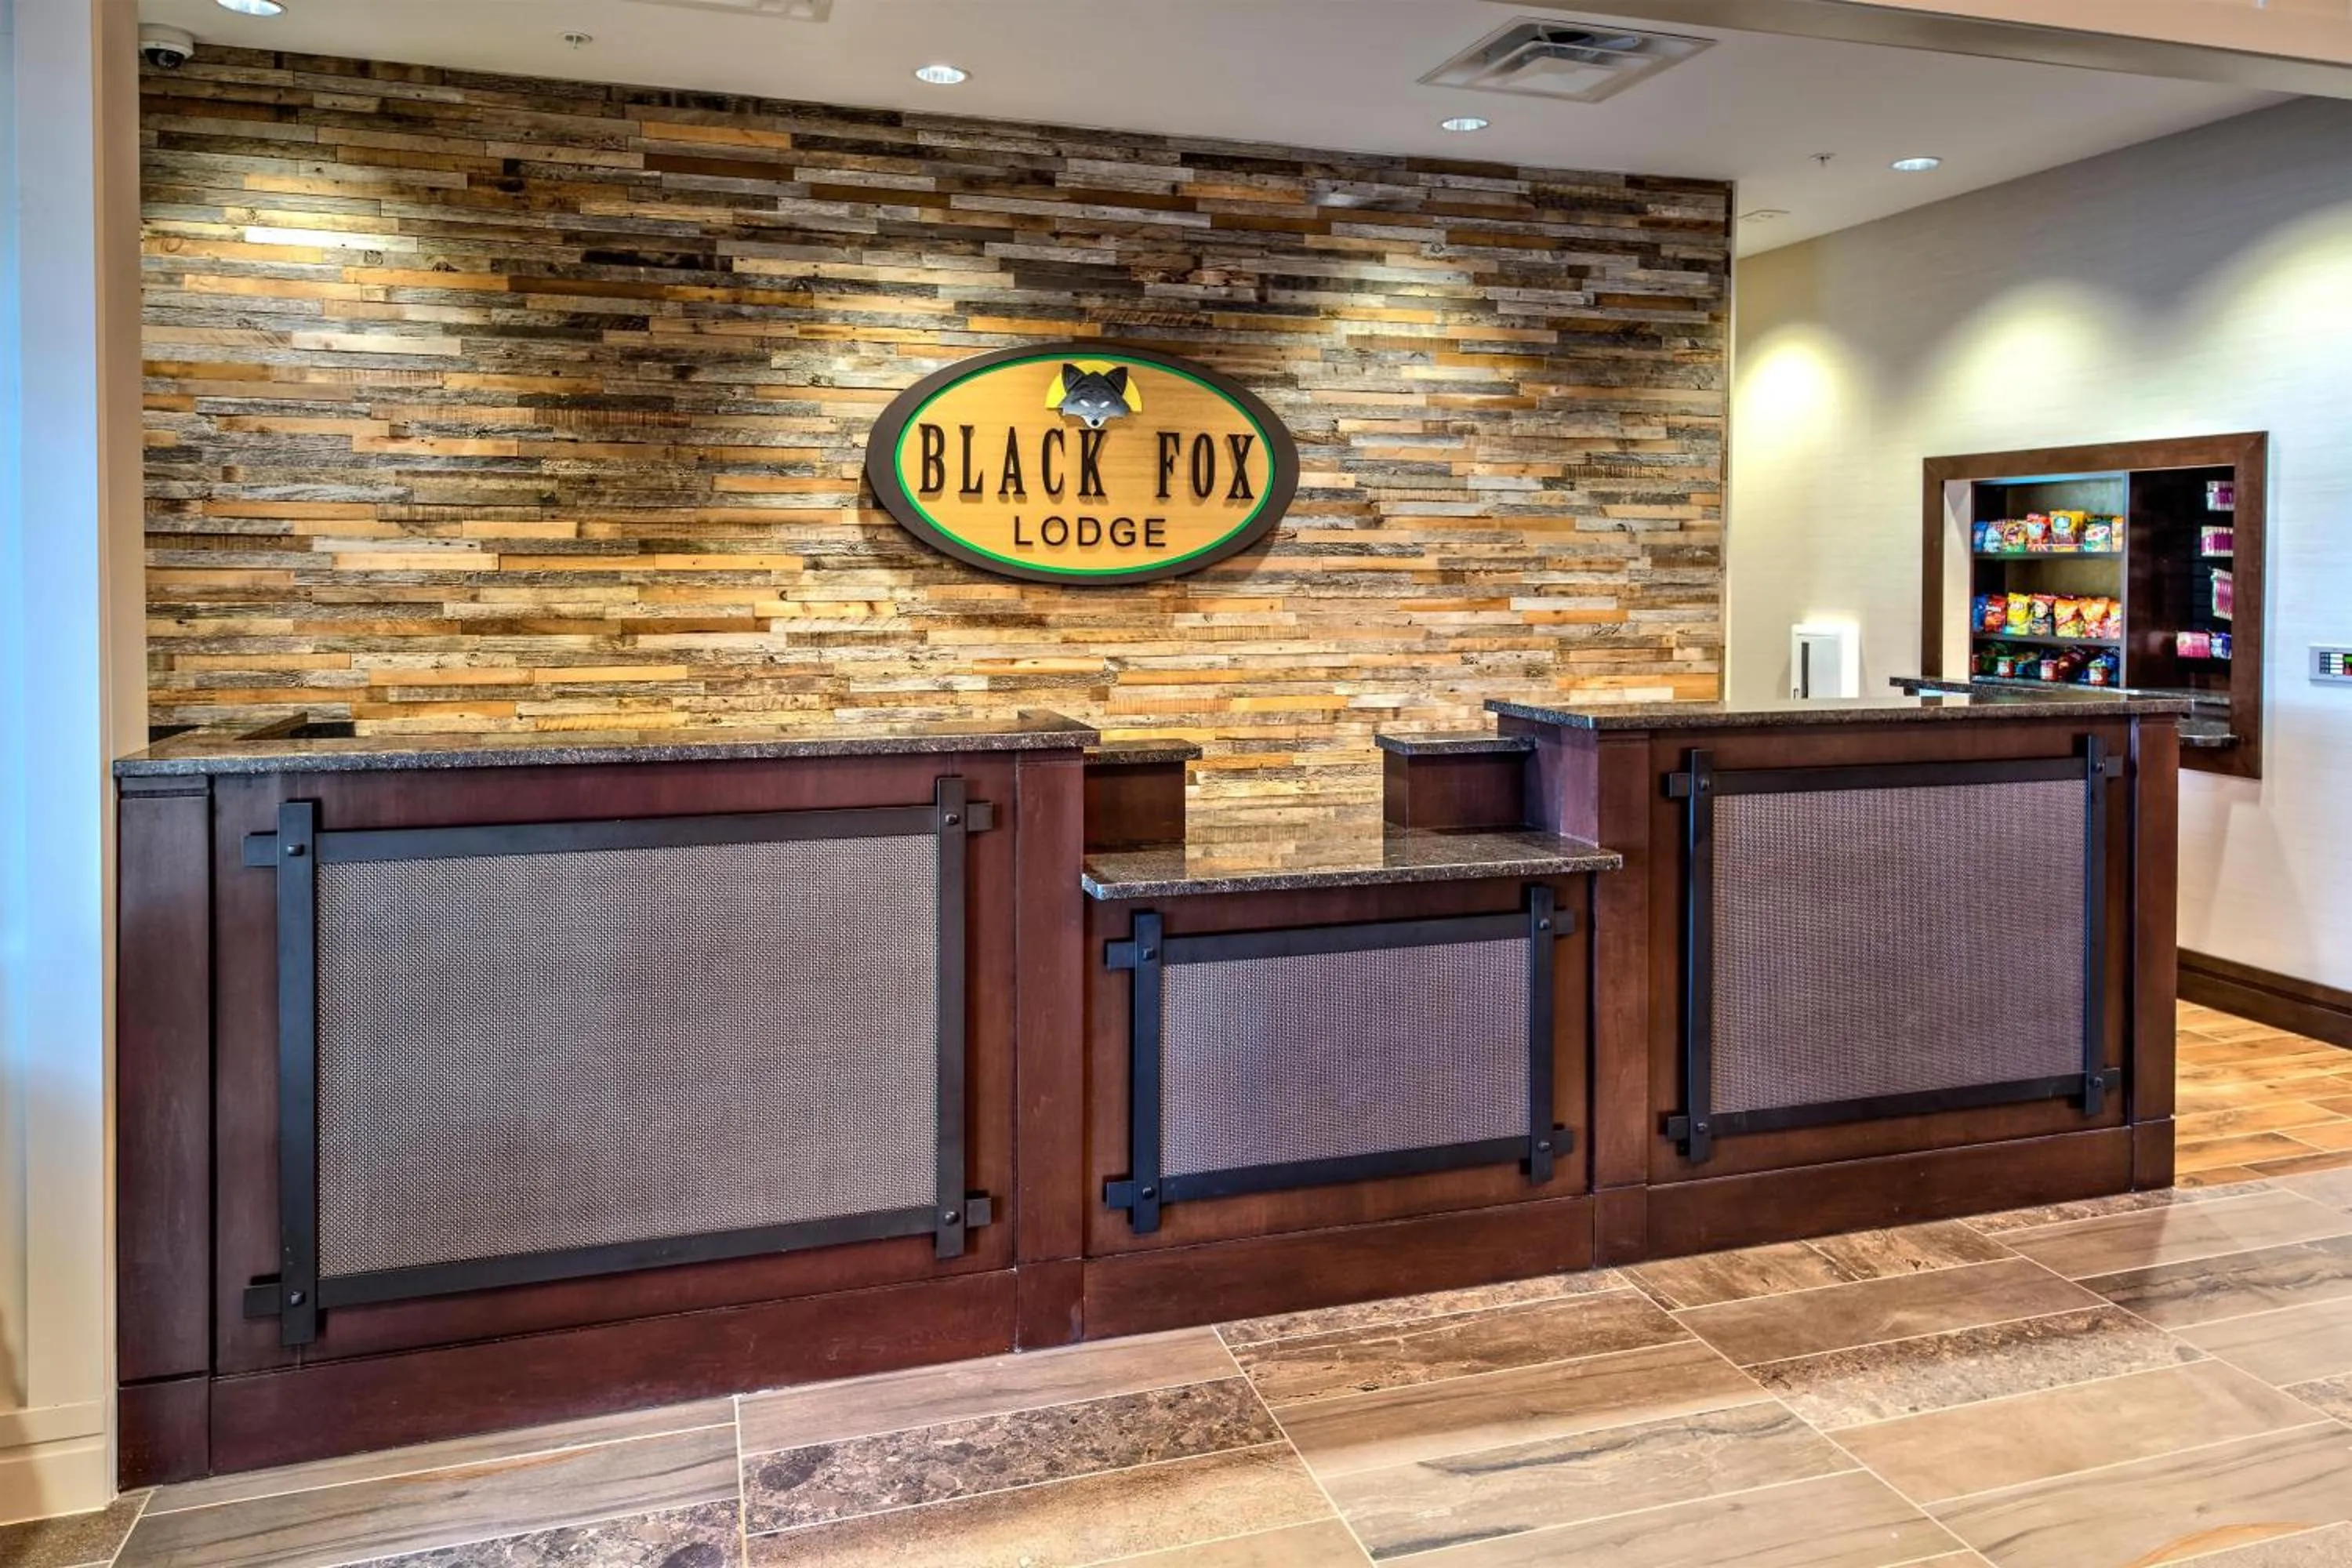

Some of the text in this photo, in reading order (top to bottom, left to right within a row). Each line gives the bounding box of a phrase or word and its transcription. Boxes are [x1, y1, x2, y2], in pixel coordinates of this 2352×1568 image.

[919, 424, 1255, 500] BLACK FOX
[1014, 516, 1167, 547] LODGE
